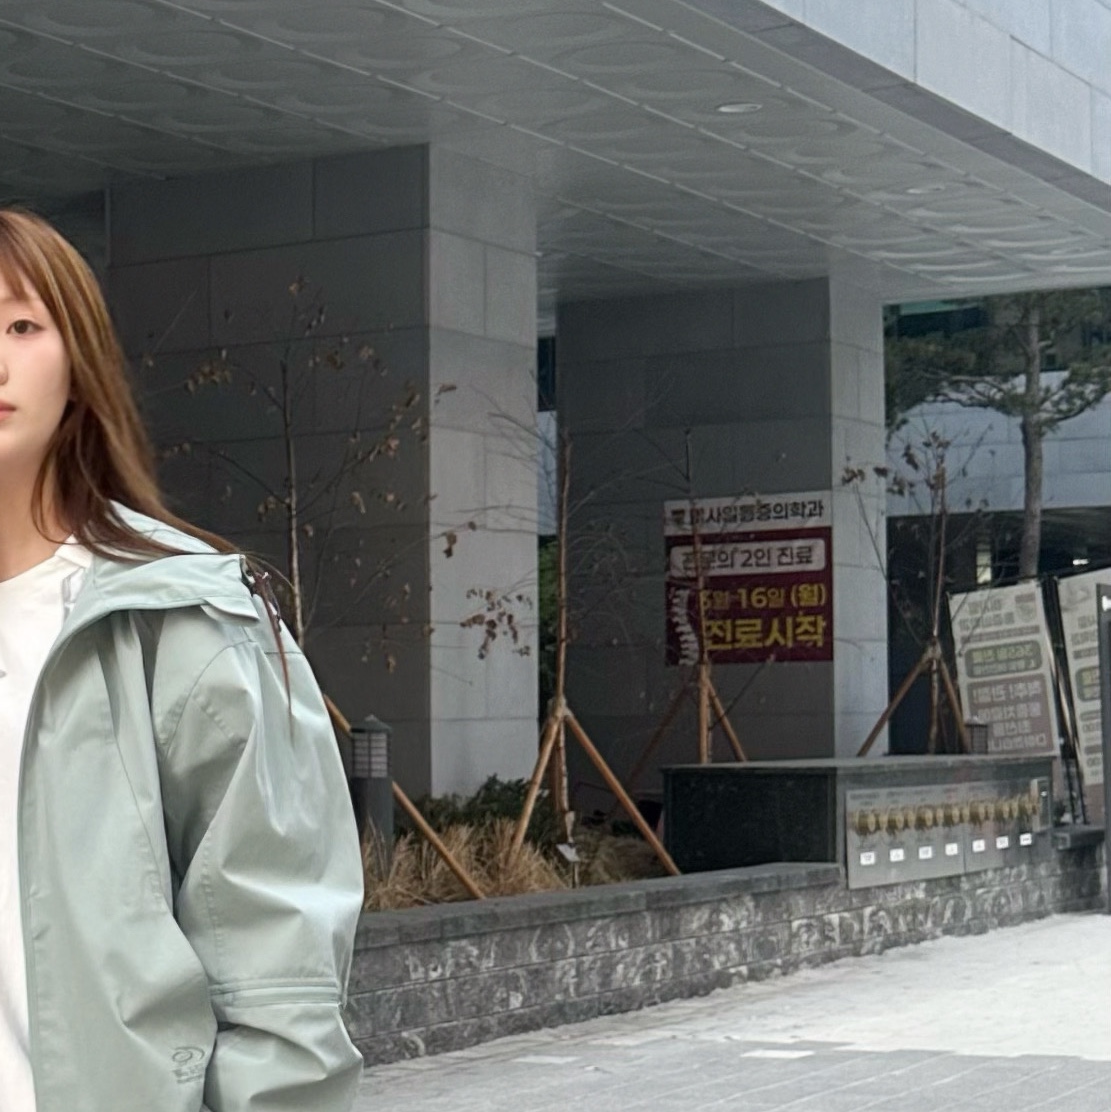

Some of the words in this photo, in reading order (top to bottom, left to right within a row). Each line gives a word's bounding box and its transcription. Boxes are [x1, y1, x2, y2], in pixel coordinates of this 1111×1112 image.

[741, 548, 771, 568] 2인
[778, 546, 813, 566] 진료
[738, 587, 785, 608] 16일
[791, 583, 826, 607] (월)
[704, 615, 825, 649] 진료시작
